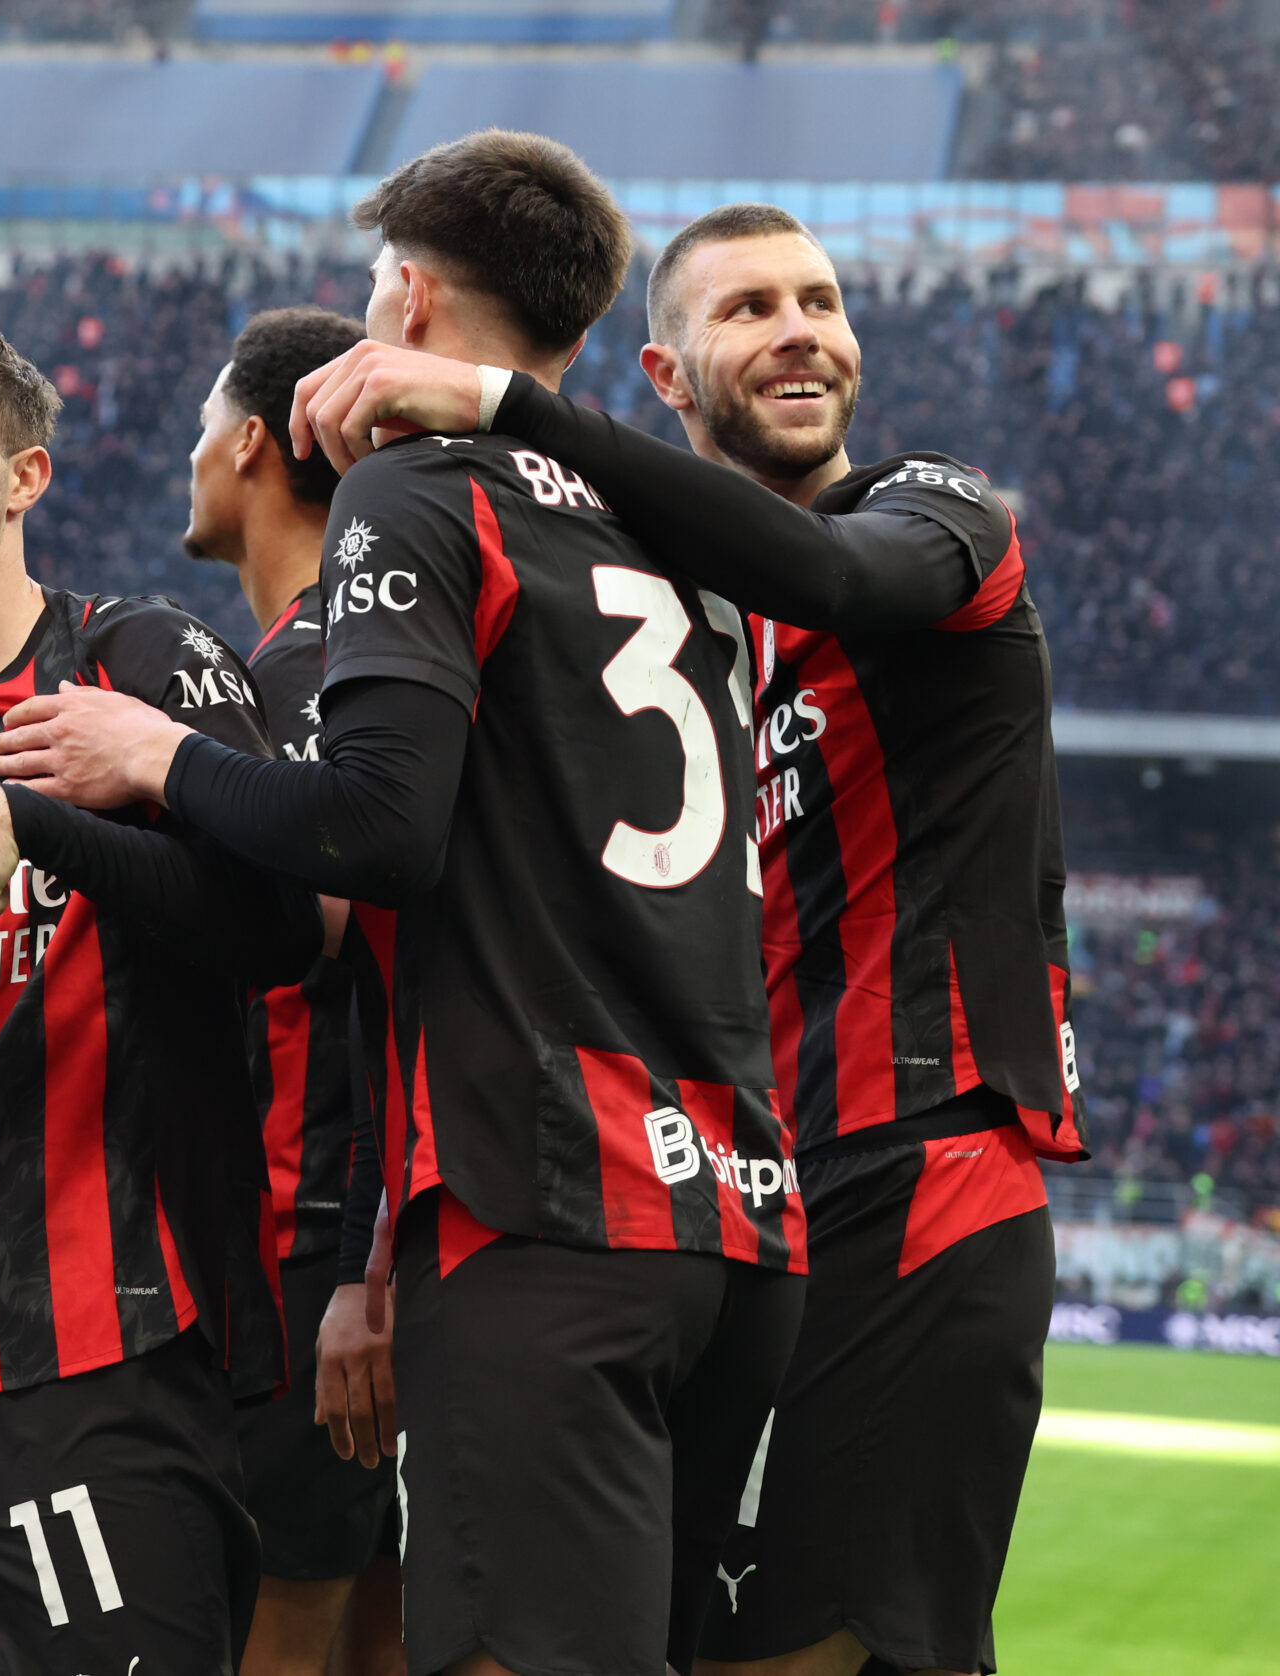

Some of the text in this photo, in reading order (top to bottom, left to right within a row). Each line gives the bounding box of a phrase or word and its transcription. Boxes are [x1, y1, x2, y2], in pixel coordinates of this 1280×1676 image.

[326, 570, 418, 641] MSC
[890, 1056, 940, 1066] ULTRAWEAVE
[699, 1135, 801, 1209] bitpan
[114, 1286, 159, 1295] ULTRAWEAVE
[8, 1483, 125, 1628] 11
